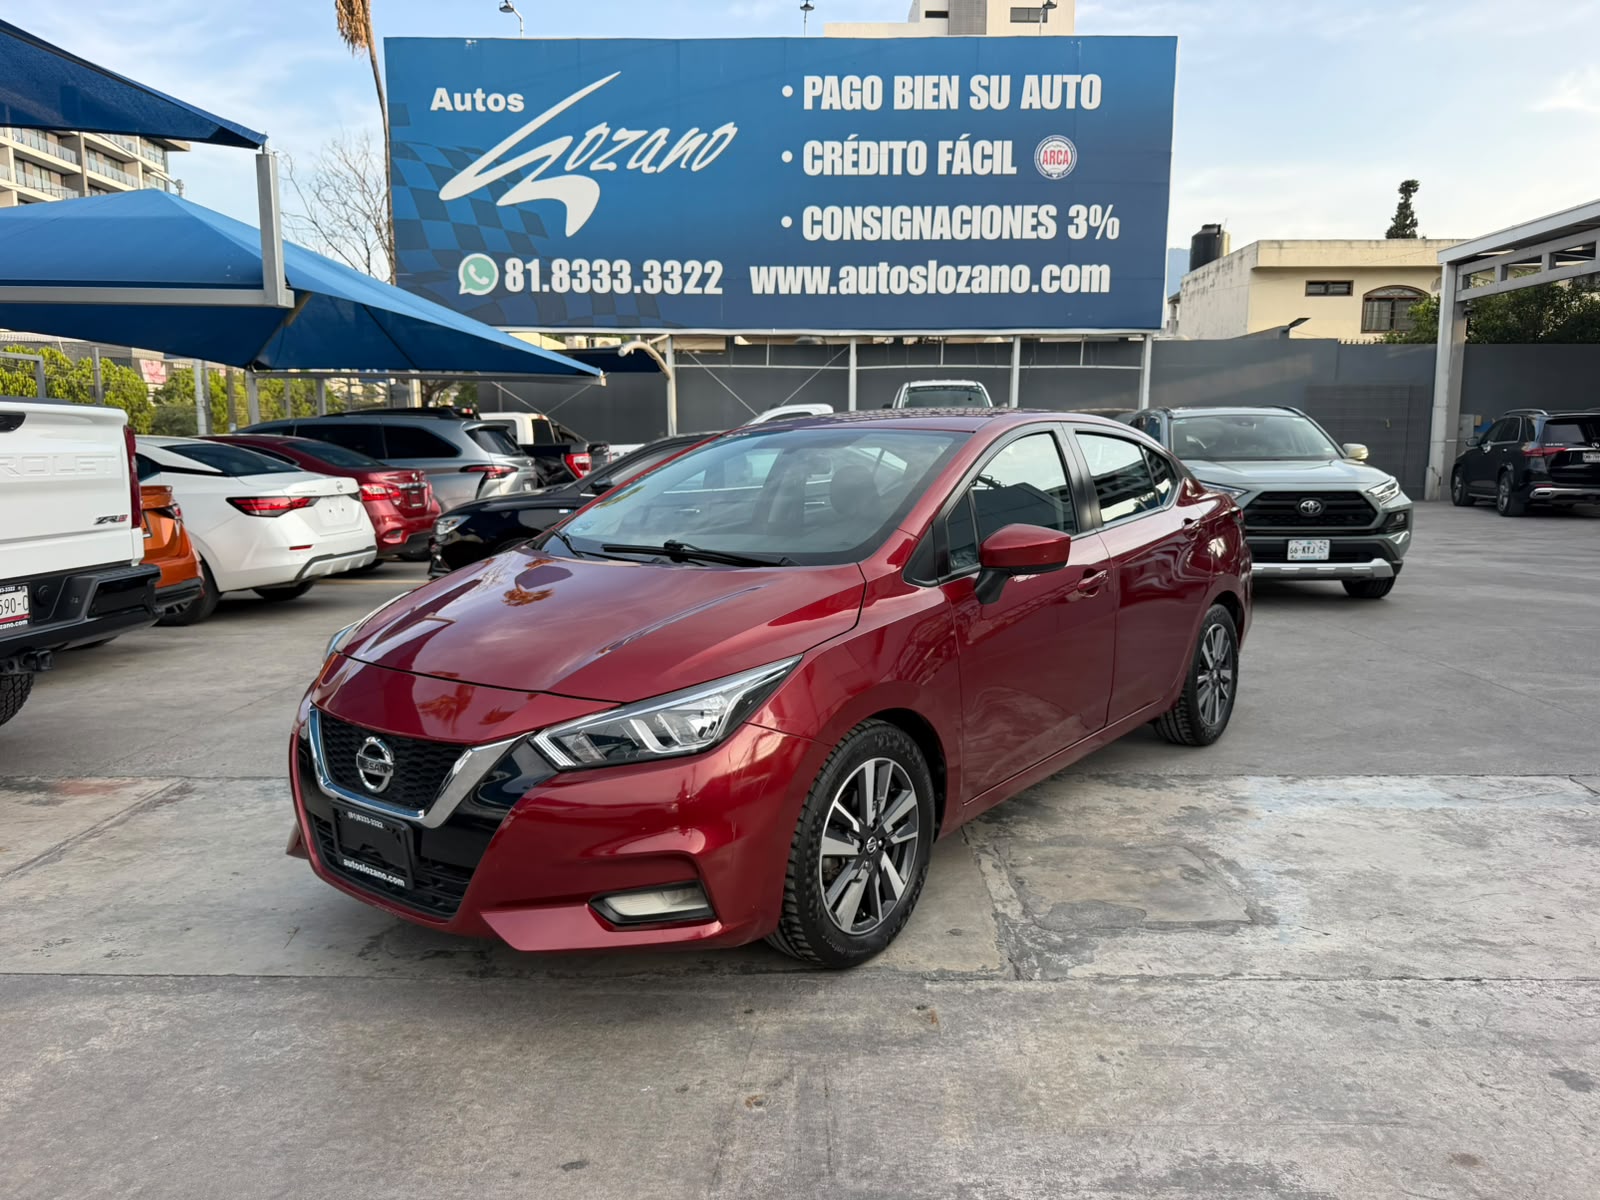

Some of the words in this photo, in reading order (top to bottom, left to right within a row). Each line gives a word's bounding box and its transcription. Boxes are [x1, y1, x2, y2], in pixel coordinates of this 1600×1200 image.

[430, 87, 525, 113] Autos
[803, 75, 883, 111] PAGO
[893, 75, 960, 111] BIEN
[969, 74, 1011, 111] SU
[1020, 73, 1102, 110] AUTO
[438, 70, 738, 238] Lozano
[803, 133, 928, 176] CRÉDITO
[937, 133, 1017, 176] FÁCIL
[1042, 149, 1070, 166] ARCA
[802, 204, 1058, 241] CONSIGNACIONES
[1067, 203, 1120, 240] 3%
[504, 257, 723, 295] 81.8333.3322
[749, 260, 1111, 295] www.autoslozano.com
[343, 859, 405, 887] autoslozano.com
